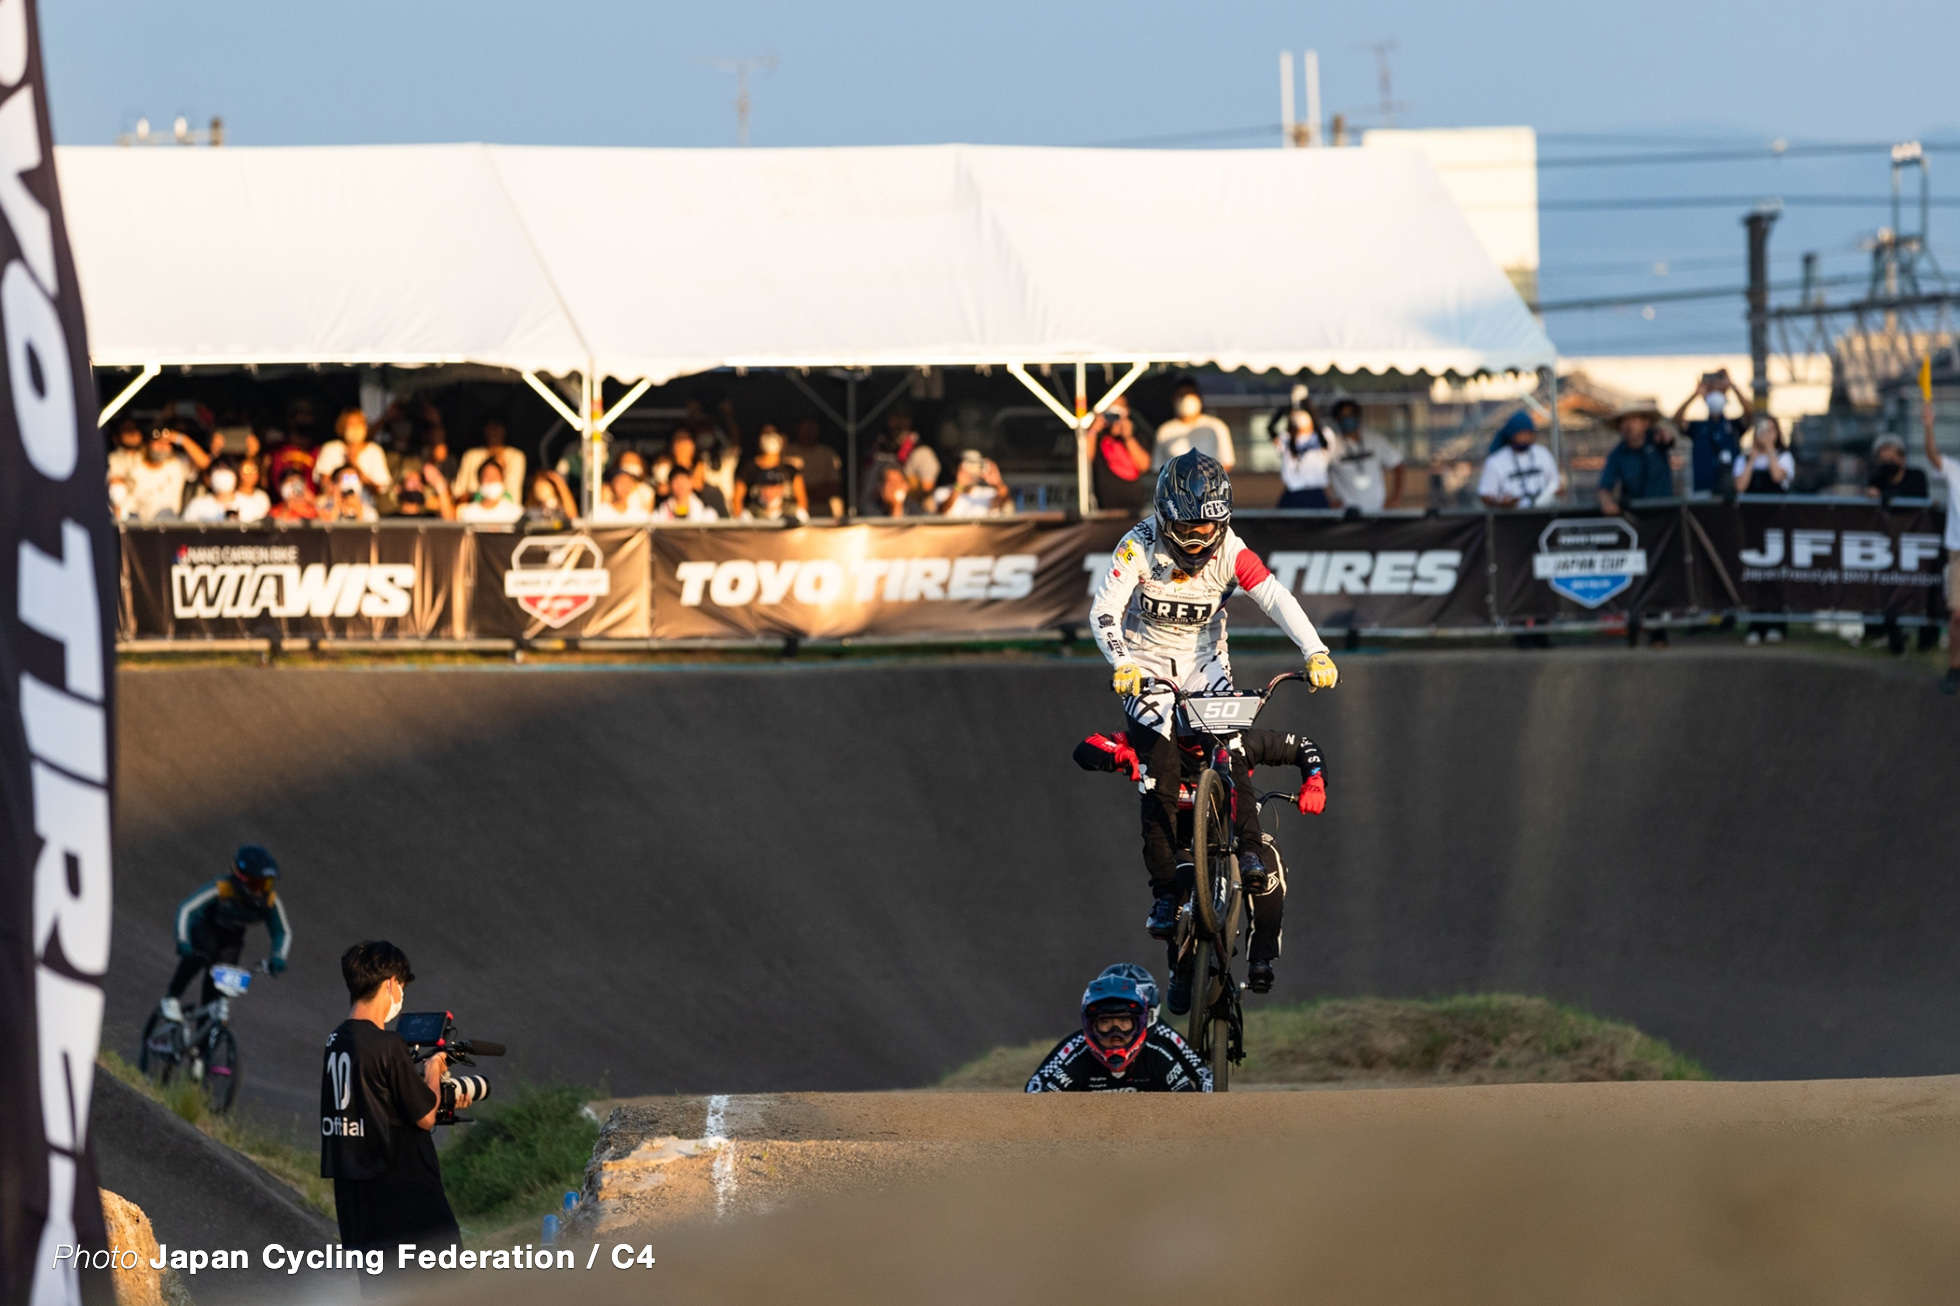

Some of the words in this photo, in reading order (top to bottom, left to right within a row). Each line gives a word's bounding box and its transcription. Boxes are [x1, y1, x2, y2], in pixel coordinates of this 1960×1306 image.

[1266, 549, 1463, 596] TIRES
[1738, 528, 1942, 571] JFBF
[171, 563, 415, 619] WIAWIS
[675, 559, 843, 607] TOYO
[846, 553, 1039, 601] TIRES
[1203, 701, 1241, 719] 50
[327, 1051, 351, 1110] 10
